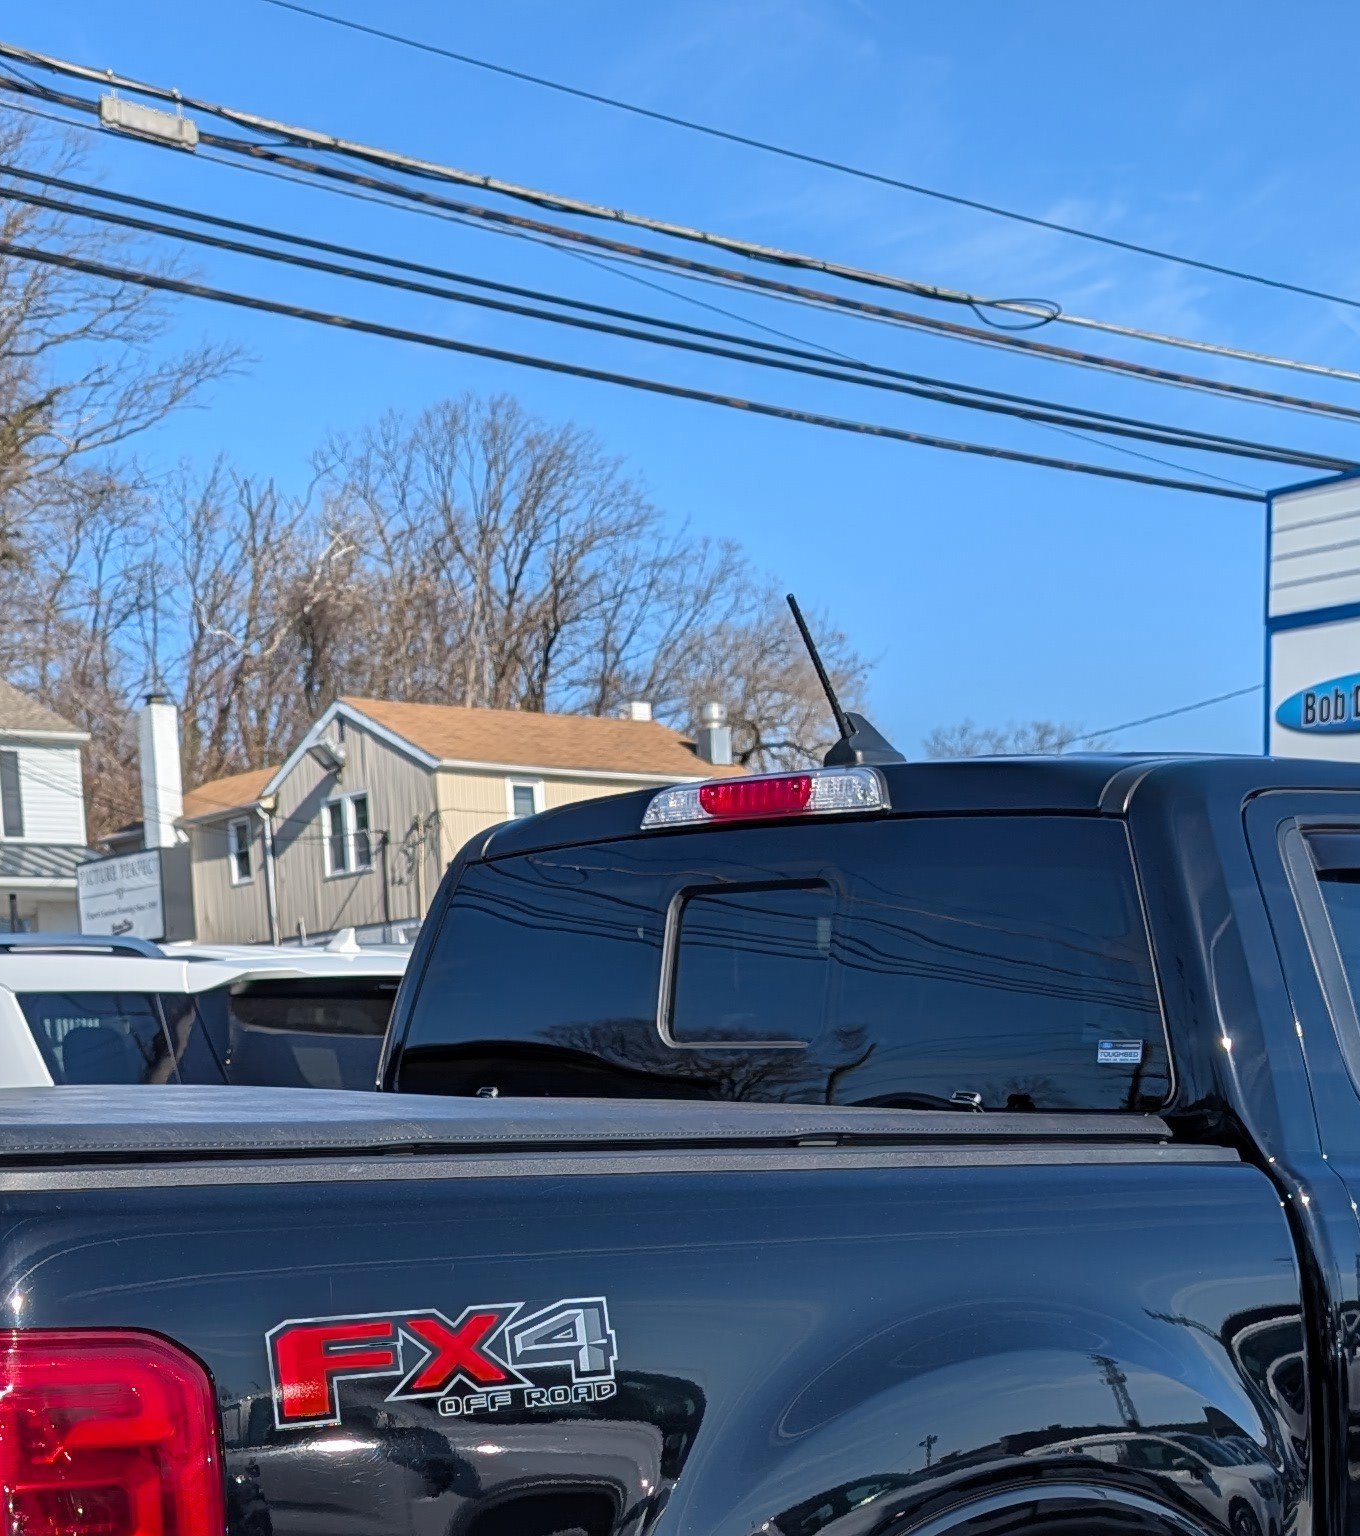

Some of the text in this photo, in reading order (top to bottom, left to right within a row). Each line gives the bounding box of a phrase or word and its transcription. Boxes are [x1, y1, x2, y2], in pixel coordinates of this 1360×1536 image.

[1303, 688, 1344, 726] Bob
[266, 1297, 617, 1429] FX4
[439, 1381, 617, 1417] OFF ROAD
